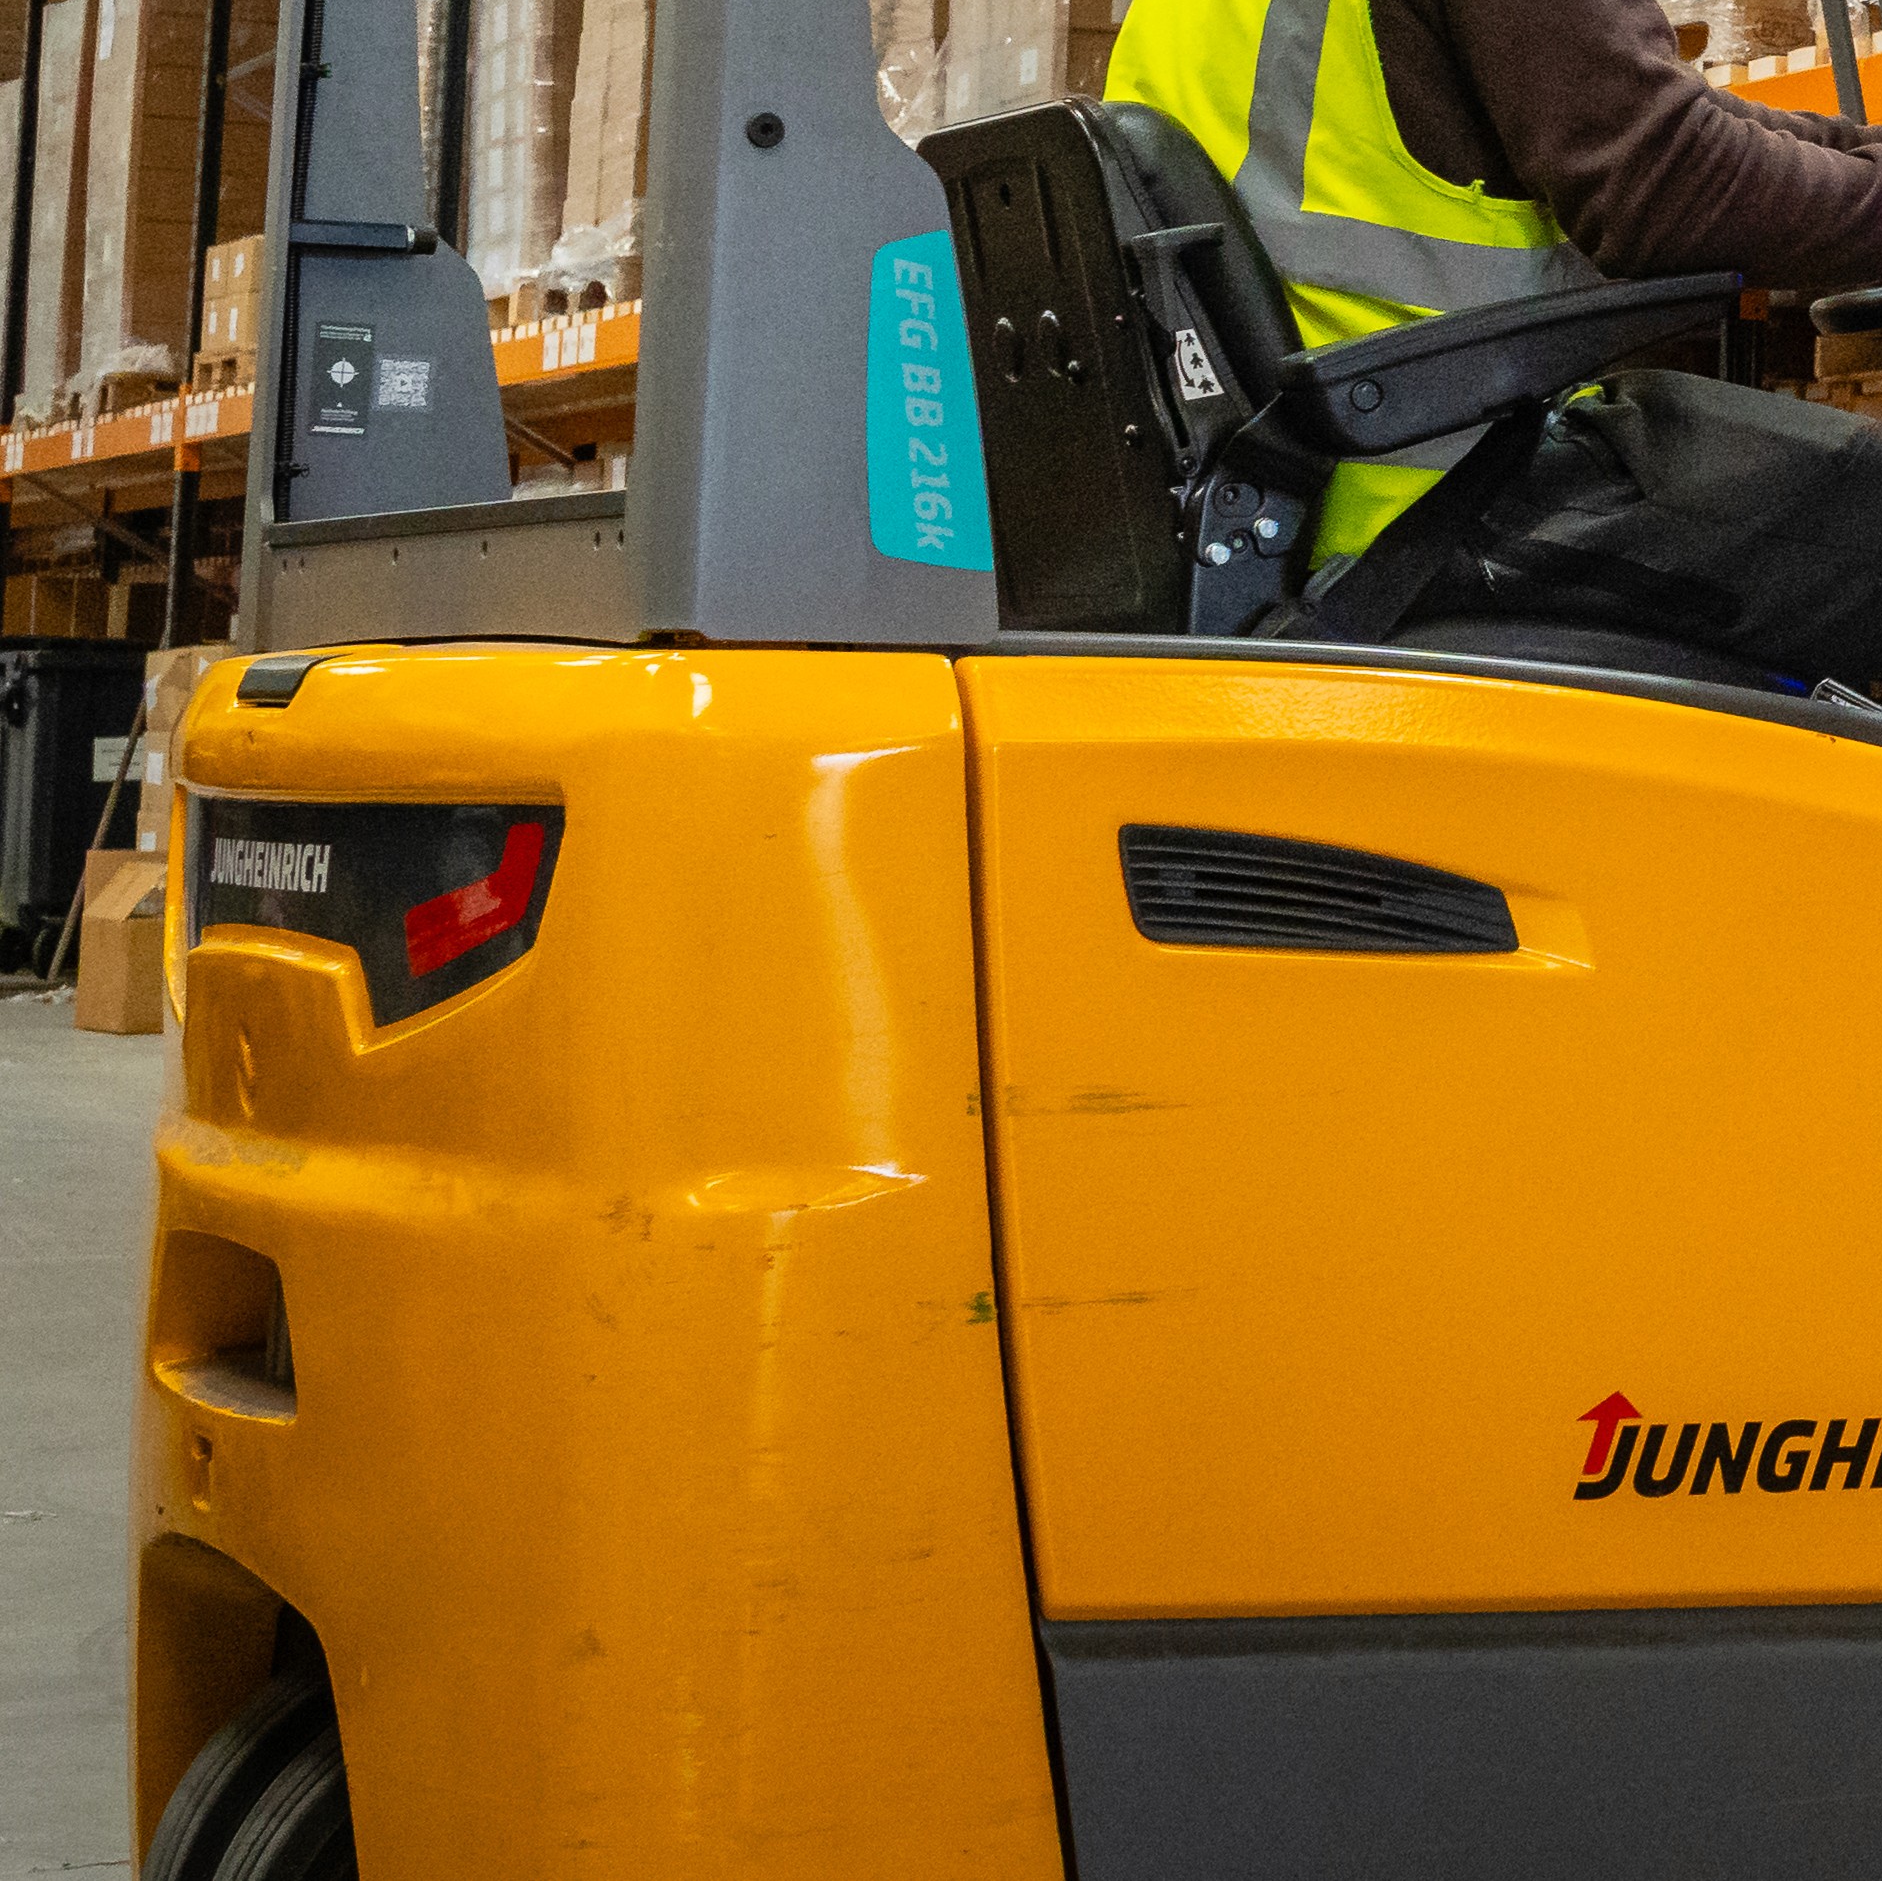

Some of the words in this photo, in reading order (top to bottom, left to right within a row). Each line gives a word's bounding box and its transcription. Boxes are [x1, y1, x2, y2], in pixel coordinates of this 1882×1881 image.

[893, 258, 938, 353] EFG
[901, 362, 944, 428] BB
[909, 437, 954, 552] 216k
[210, 837, 331, 894] JUNGHEINRICH
